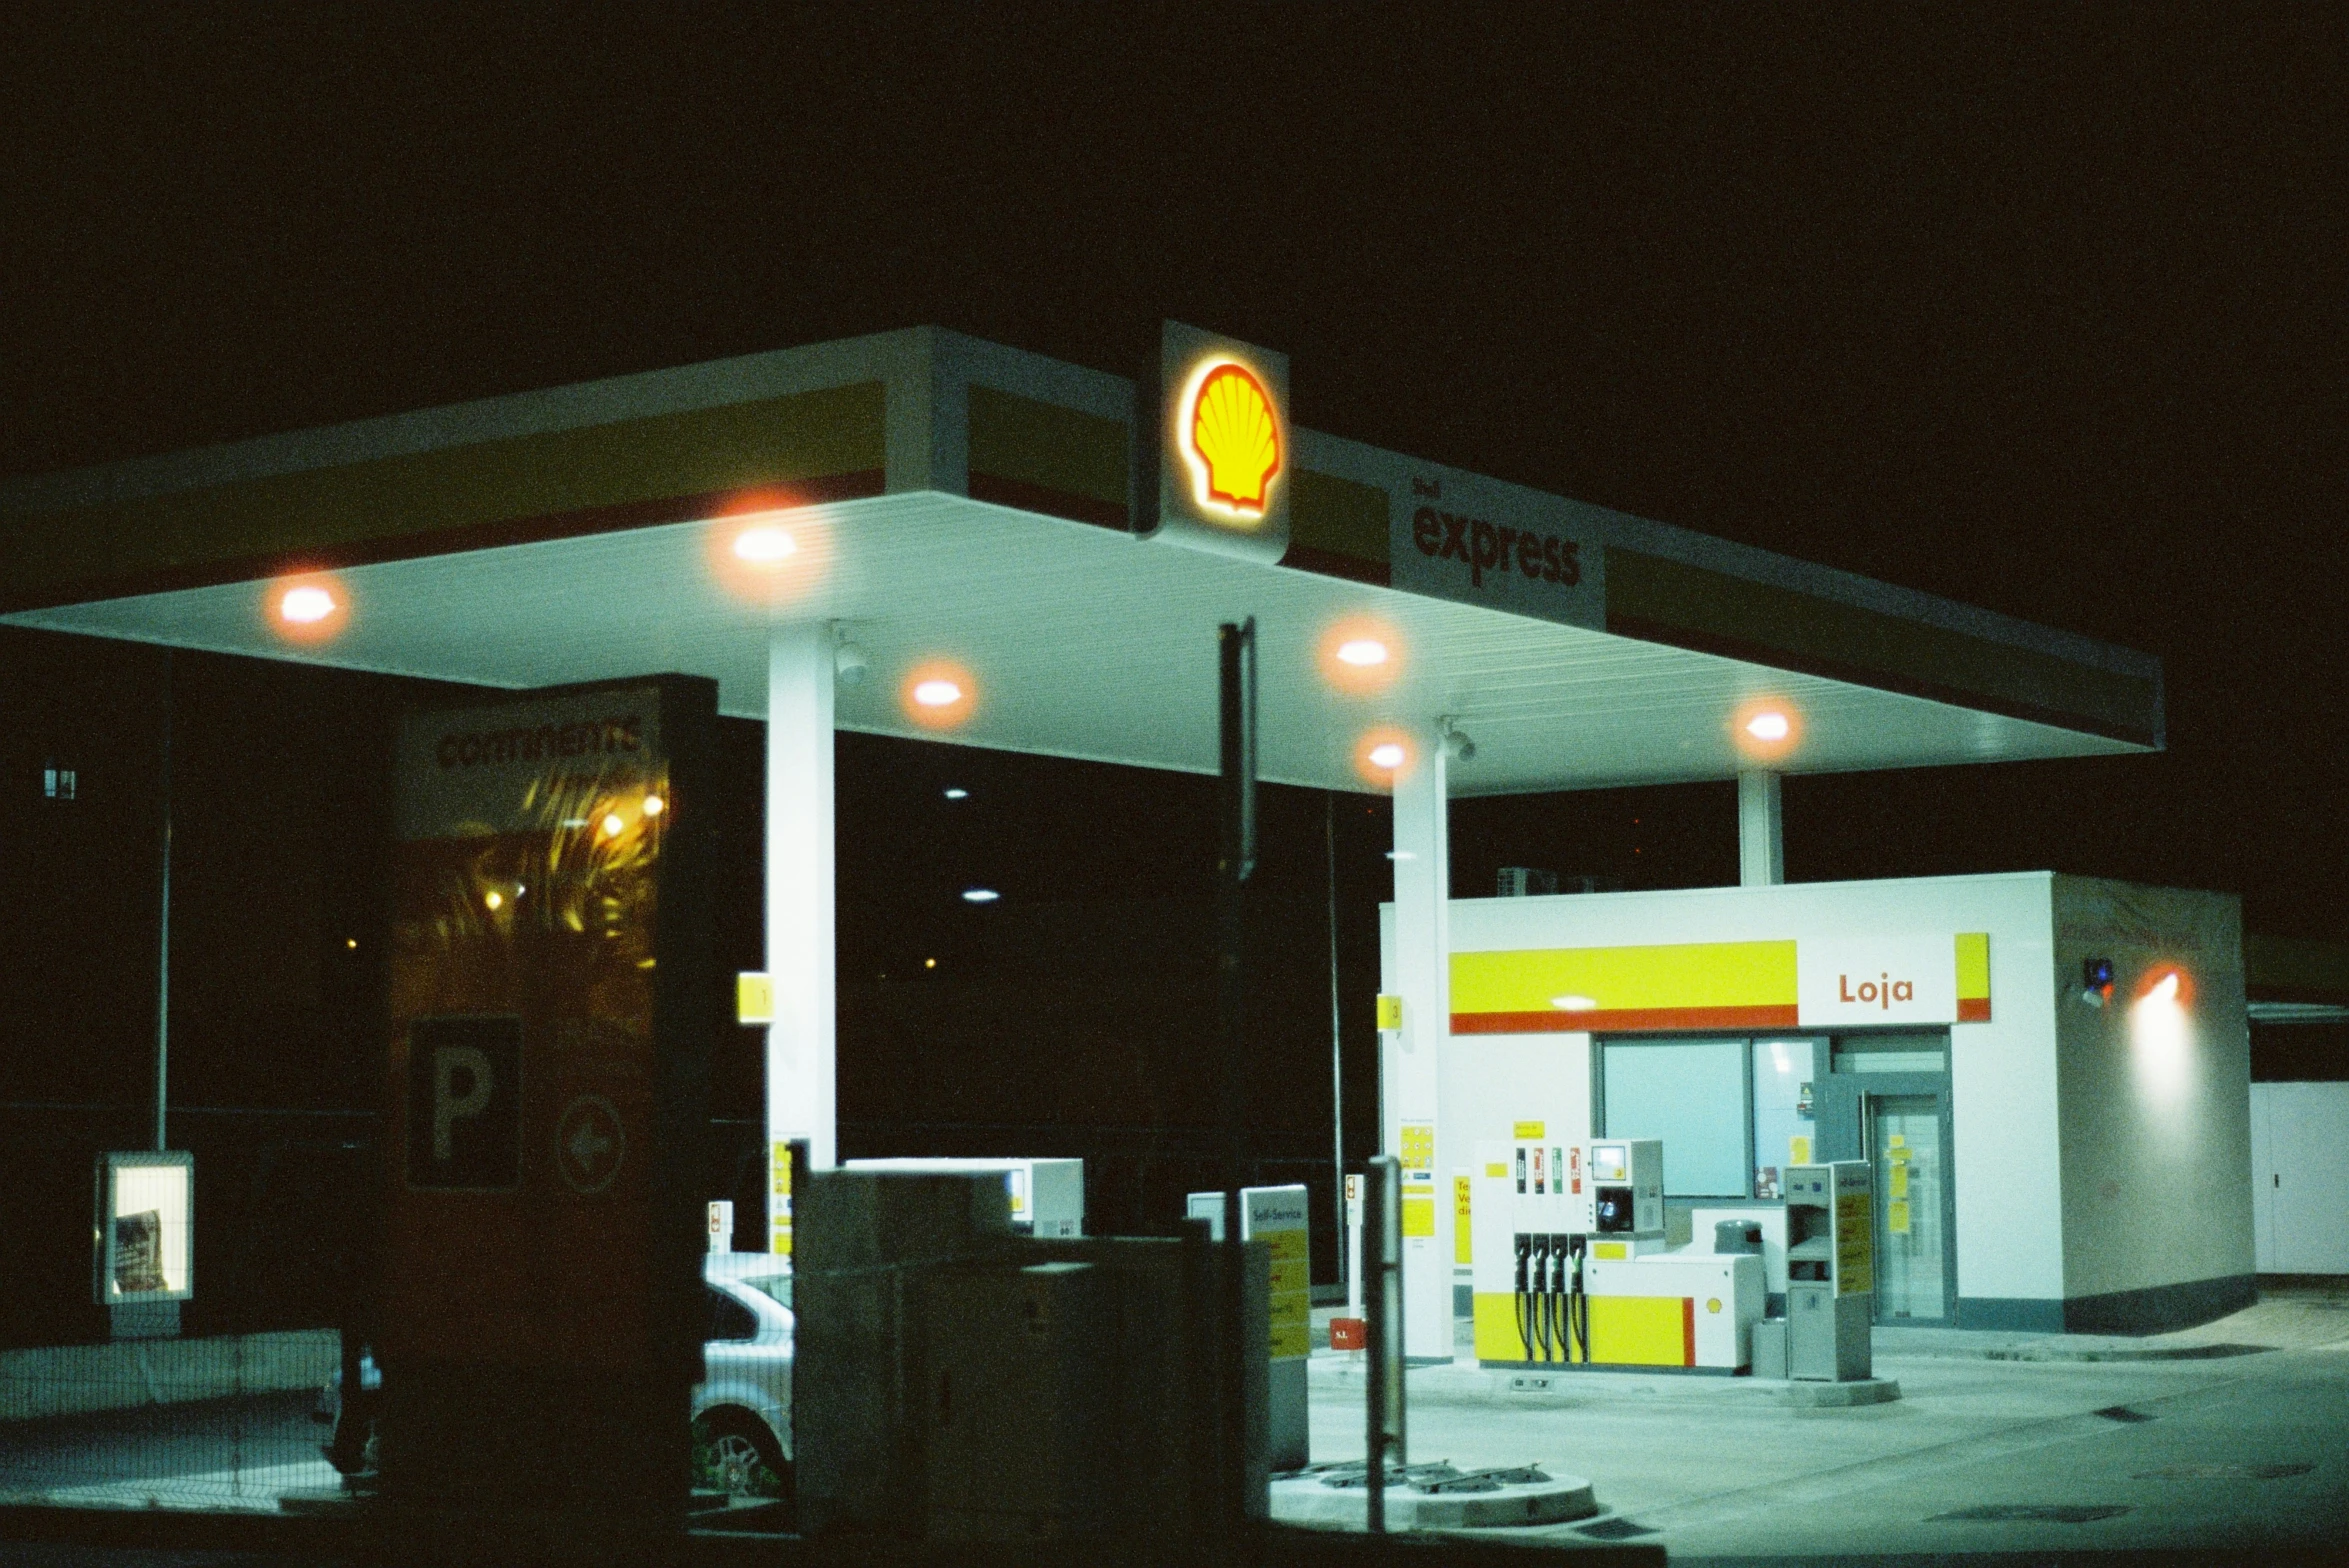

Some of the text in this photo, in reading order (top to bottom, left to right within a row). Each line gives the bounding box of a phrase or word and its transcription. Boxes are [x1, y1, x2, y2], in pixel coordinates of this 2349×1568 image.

[1412, 507, 1581, 588] express
[1838, 971, 1914, 1010] Loja
[432, 1044, 493, 1160] P
[1253, 1208, 1302, 1222] Self-Service
